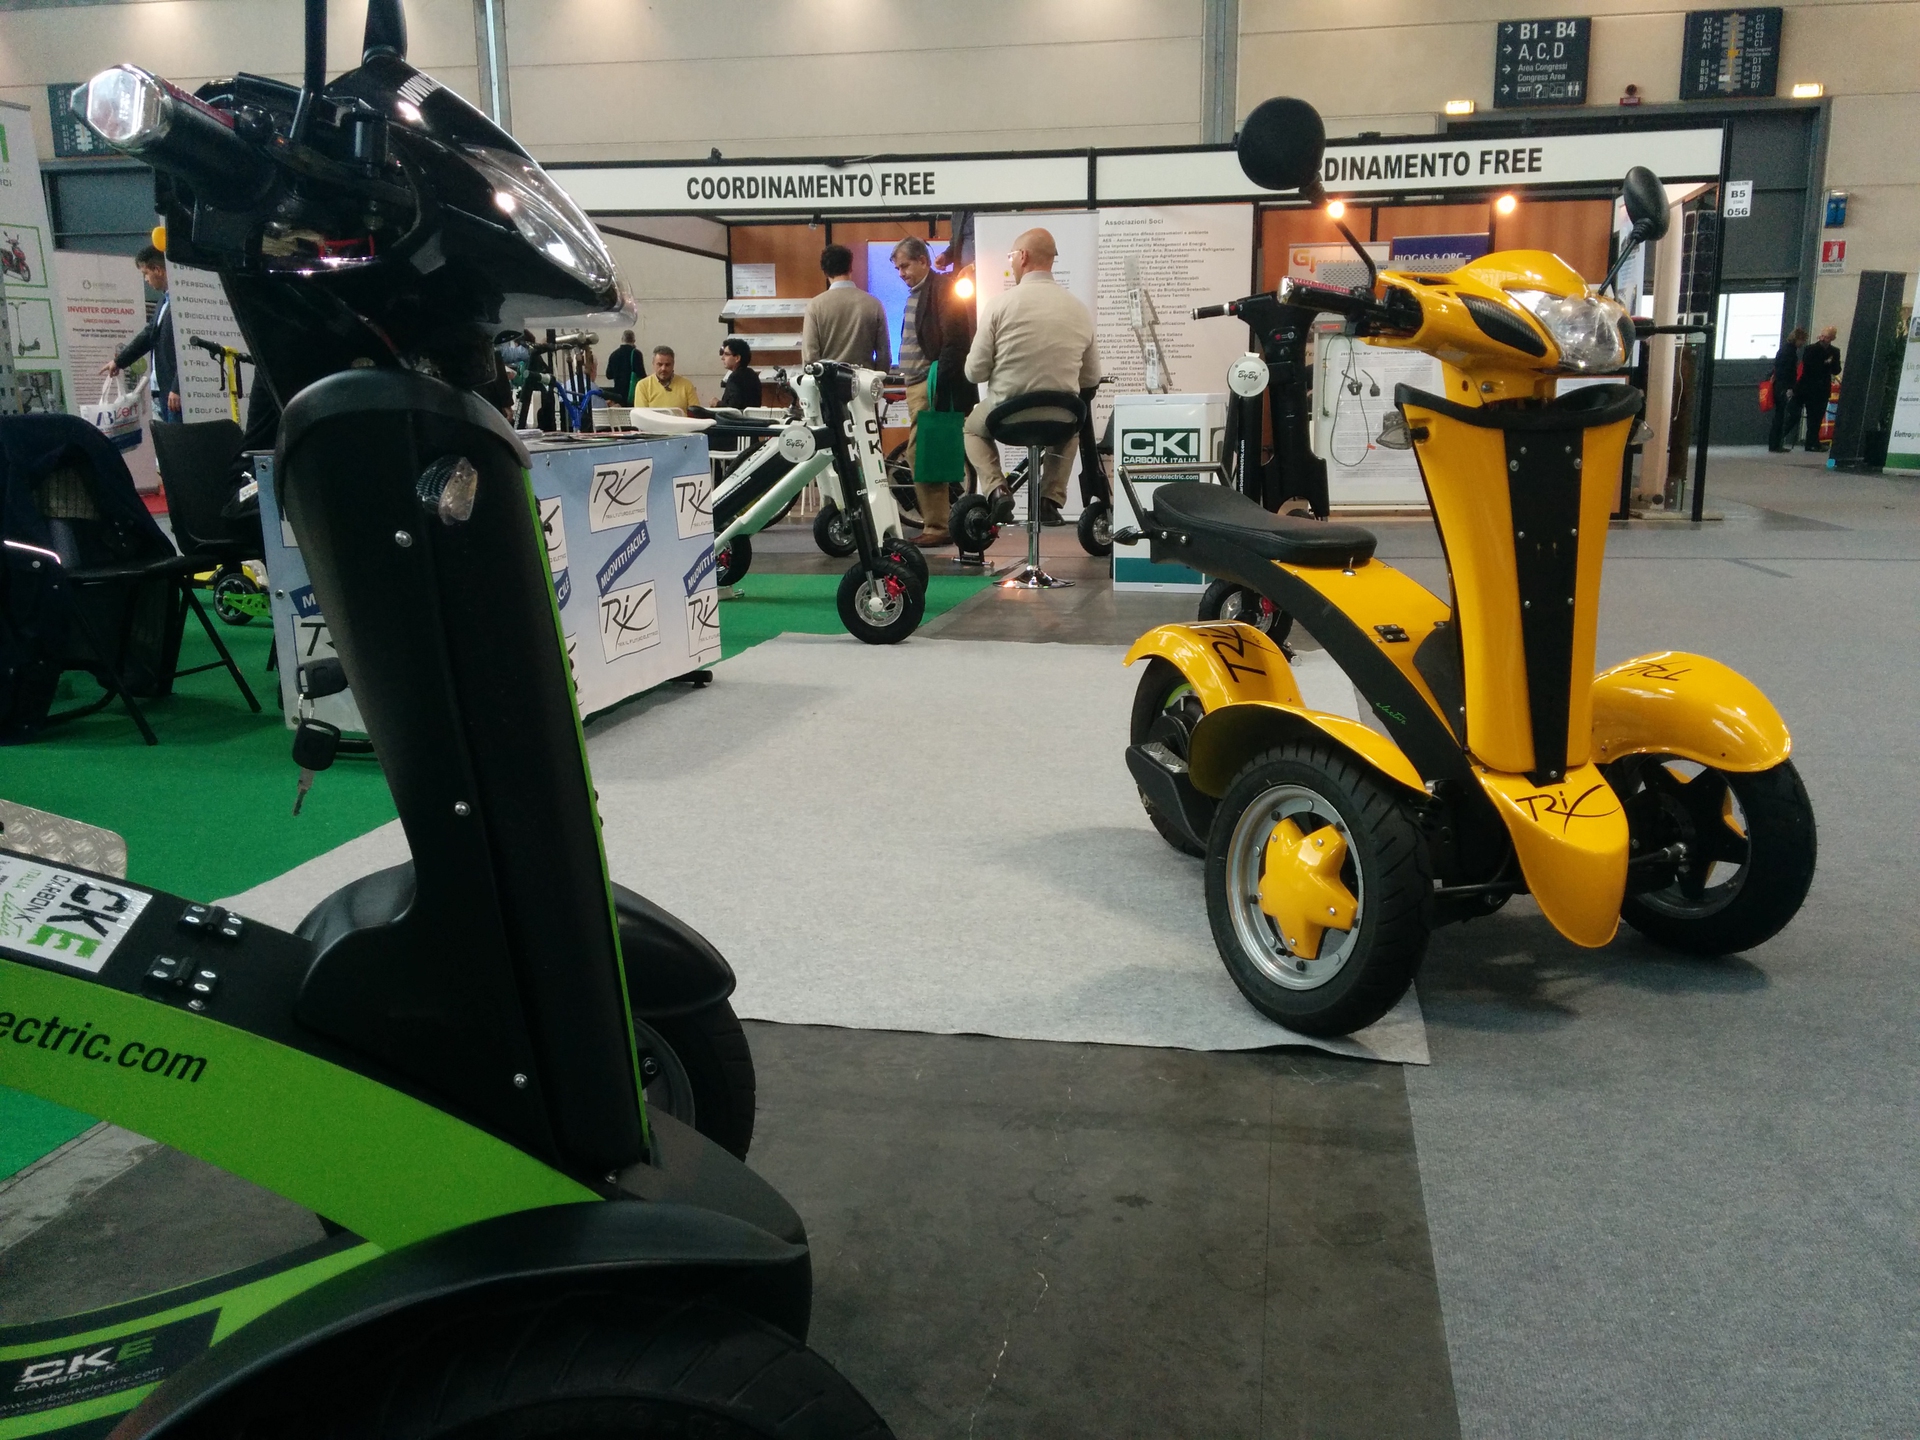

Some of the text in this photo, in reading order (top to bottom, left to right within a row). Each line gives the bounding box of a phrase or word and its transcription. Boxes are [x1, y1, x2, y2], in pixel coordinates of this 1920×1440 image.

[1520, 23, 1538, 40] B1
[1556, 21, 1576, 38] B4
[1703, 17, 1713, 25] A7
[1518, 42, 1564, 61] A, C, D
[1518, 62, 1568, 72] Area Congressi
[1518, 72, 1566, 83] Congress Area
[1319, 148, 1543, 182] DINAMENTO FREE
[686, 172, 936, 200] COORDINAMENTO FREE
[1730, 190, 1746, 198] B5
[1727, 208, 1748, 216] 056
[68, 306, 135, 315] INVERTER COPELAND
[1123, 432, 1199, 456] CKI
[1123, 456, 1160, 464] CARBON
[600, 529, 646, 590] MUOVITI FACILE
[23, 874, 71, 914] CARBON
[14, 1369, 98, 1392] CARBON
